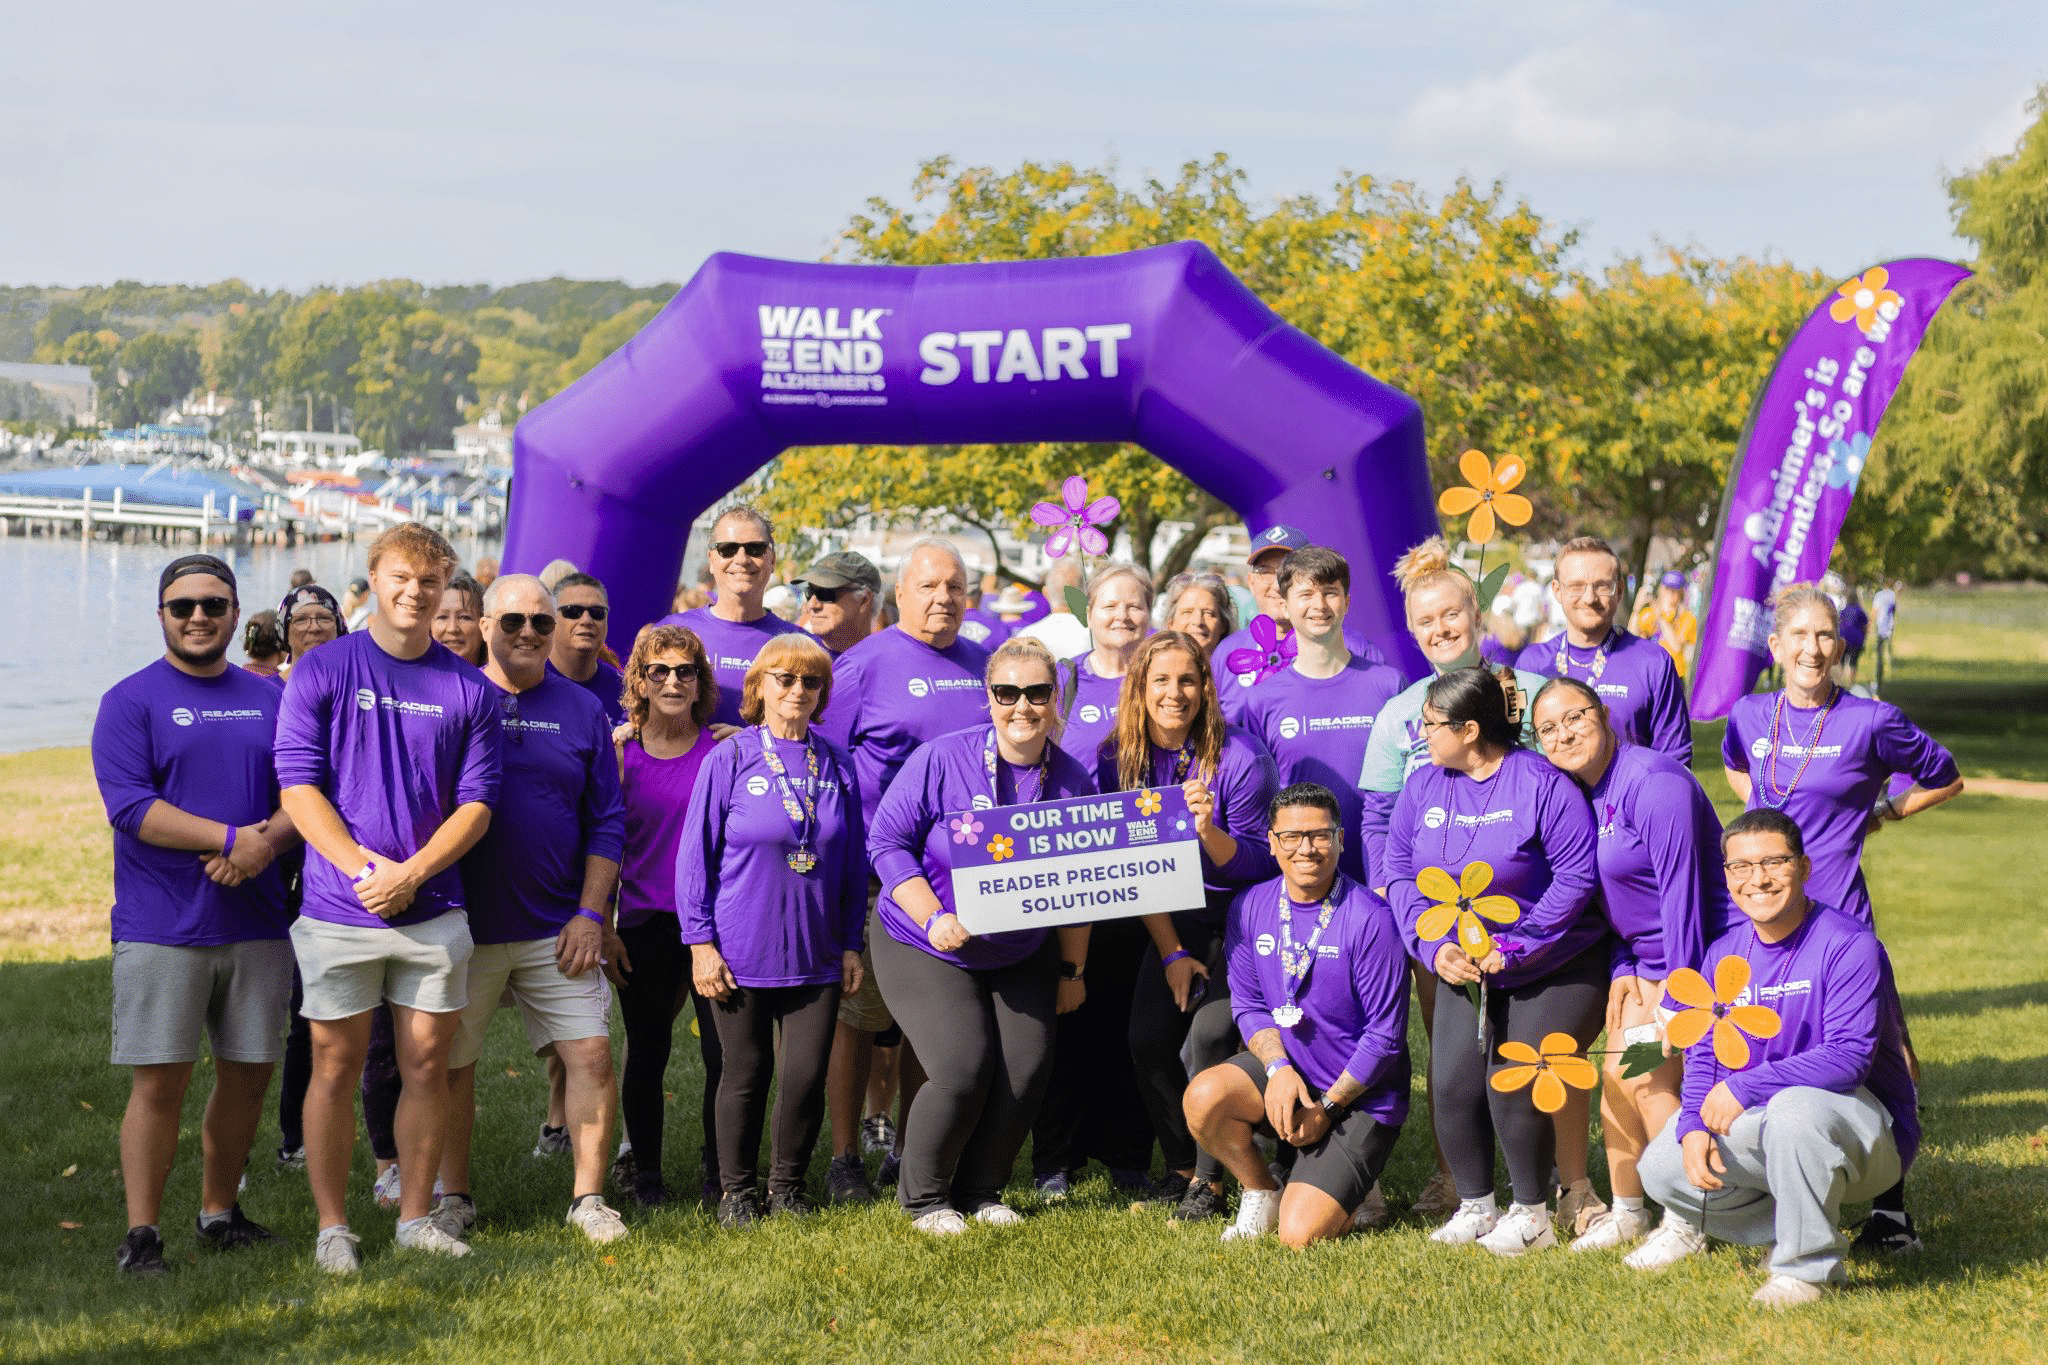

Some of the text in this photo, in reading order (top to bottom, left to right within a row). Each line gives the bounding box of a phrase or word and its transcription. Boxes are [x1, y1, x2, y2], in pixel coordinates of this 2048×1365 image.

[758, 304, 883, 338] WALK
[793, 340, 884, 374] END
[919, 323, 1132, 386] START
[1818, 400, 1853, 441] So
[1842, 346, 1876, 398] are
[1866, 297, 1906, 343] we.
[1804, 356, 1839, 387] is
[1010, 800, 1124, 831] OUR TIME
[1126, 819, 1157, 830] WALK
[1029, 826, 1116, 854] IS NOW
[1136, 827, 1158, 836] END
[979, 858, 1176, 895] READER PRECISION
[1021, 886, 1139, 914] SOLUTIONS
